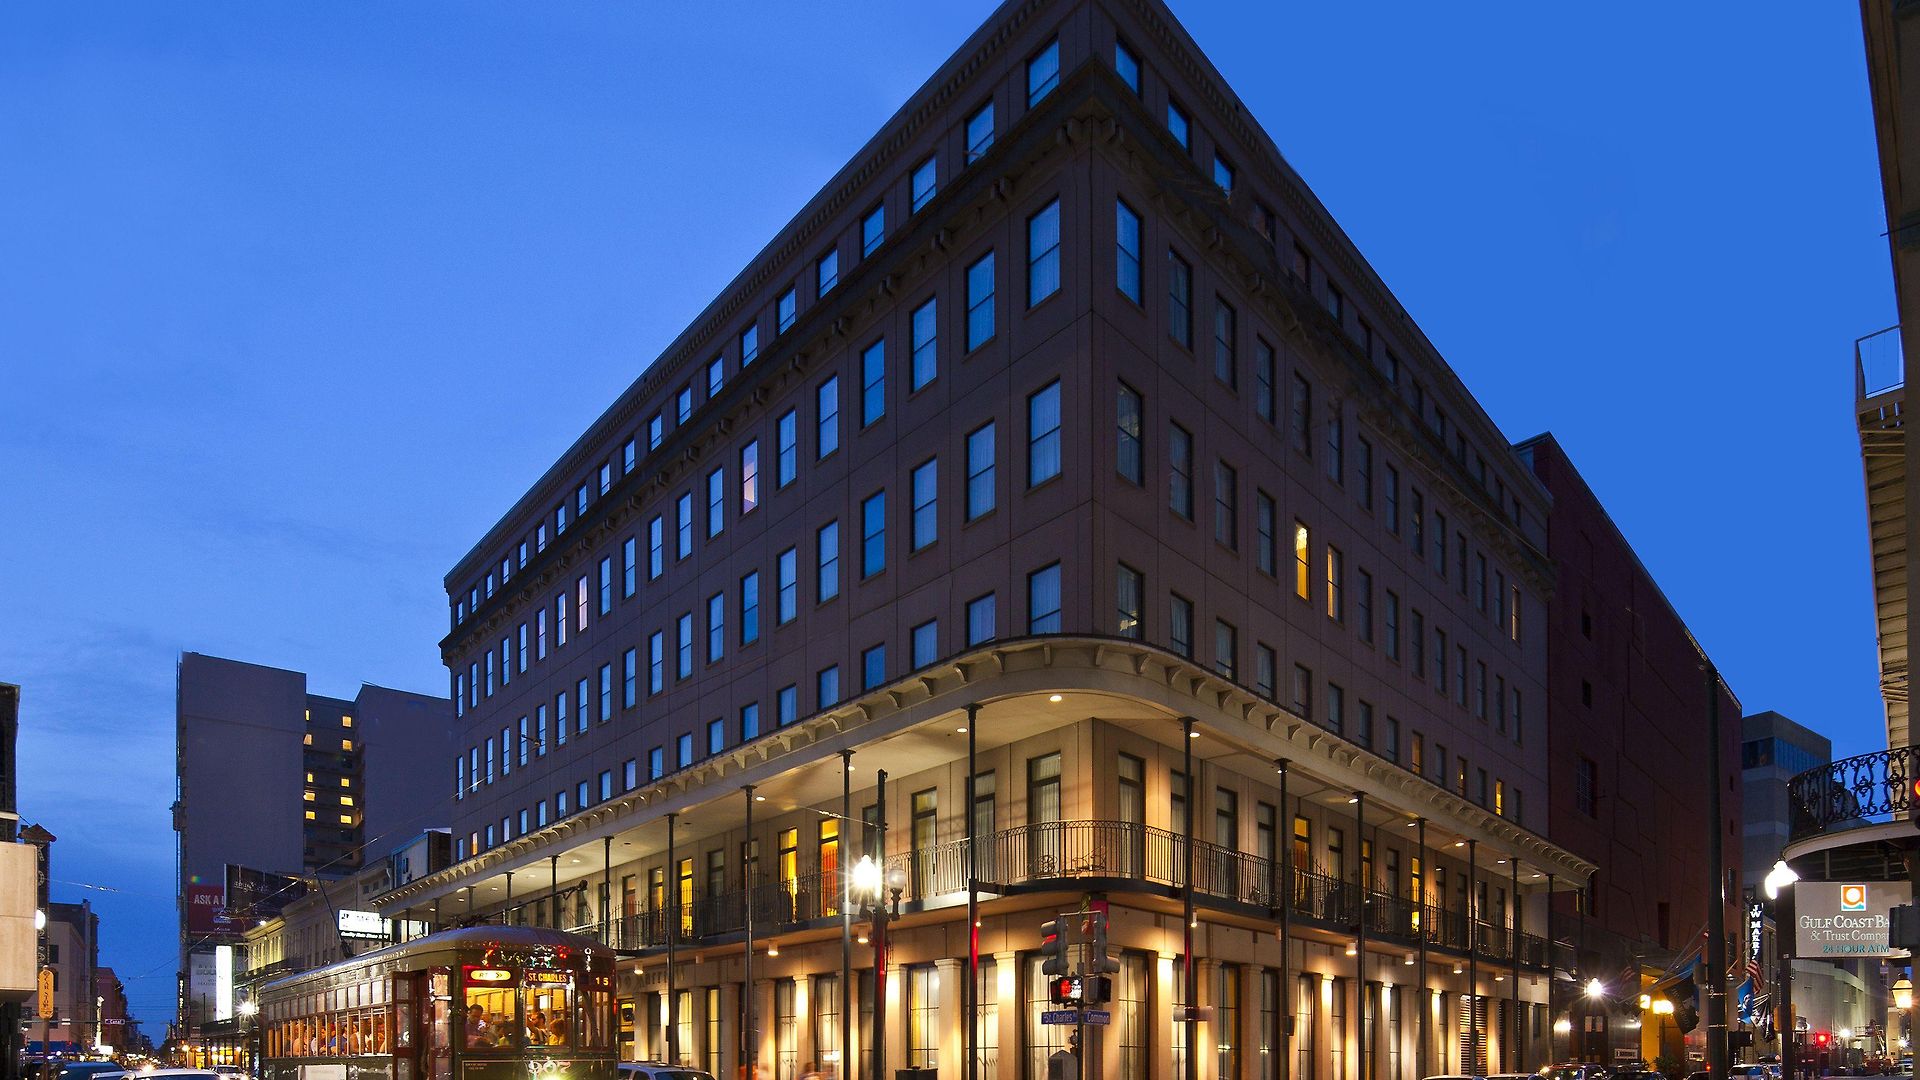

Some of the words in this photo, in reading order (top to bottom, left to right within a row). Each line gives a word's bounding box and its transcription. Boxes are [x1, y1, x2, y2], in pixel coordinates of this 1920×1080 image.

[194, 894, 211, 905] ASK
[213, 894, 220, 905] A
[1800, 915, 1832, 928] GULF
[1833, 915, 1874, 928] COAST
[1811, 930, 1820, 941] &
[1823, 930, 1850, 941] Trust
[1838, 944, 1865, 953] HOUR
[1868, 944, 1889, 953] ATM
[538, 973, 568, 983] CHARLES
[1053, 1012, 1073, 1023] Charles
